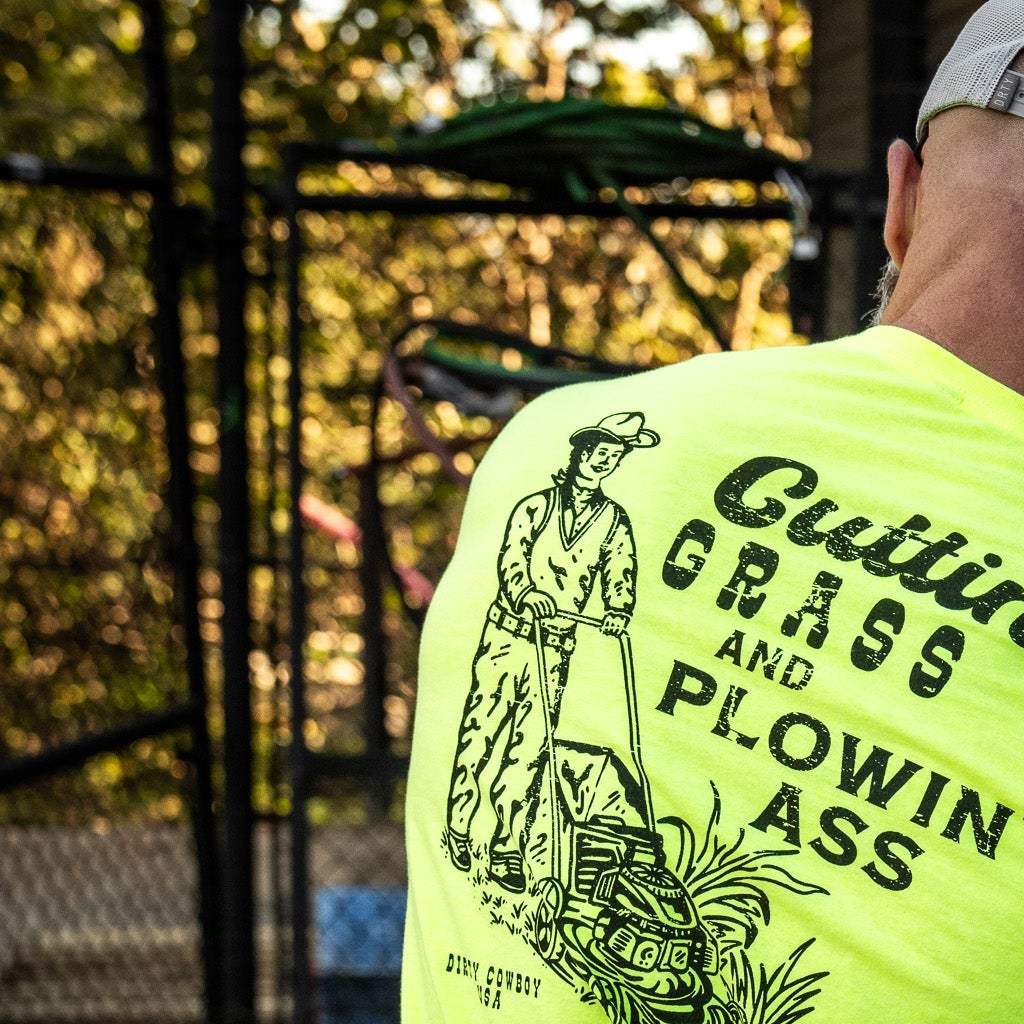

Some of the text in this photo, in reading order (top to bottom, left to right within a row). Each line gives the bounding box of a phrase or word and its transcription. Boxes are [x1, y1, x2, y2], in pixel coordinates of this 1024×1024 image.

[661, 518, 966, 699] GRASS
[714, 629, 815, 692] AND
[749, 781, 925, 892] ASS
[486, 965, 541, 998] COWBOY
